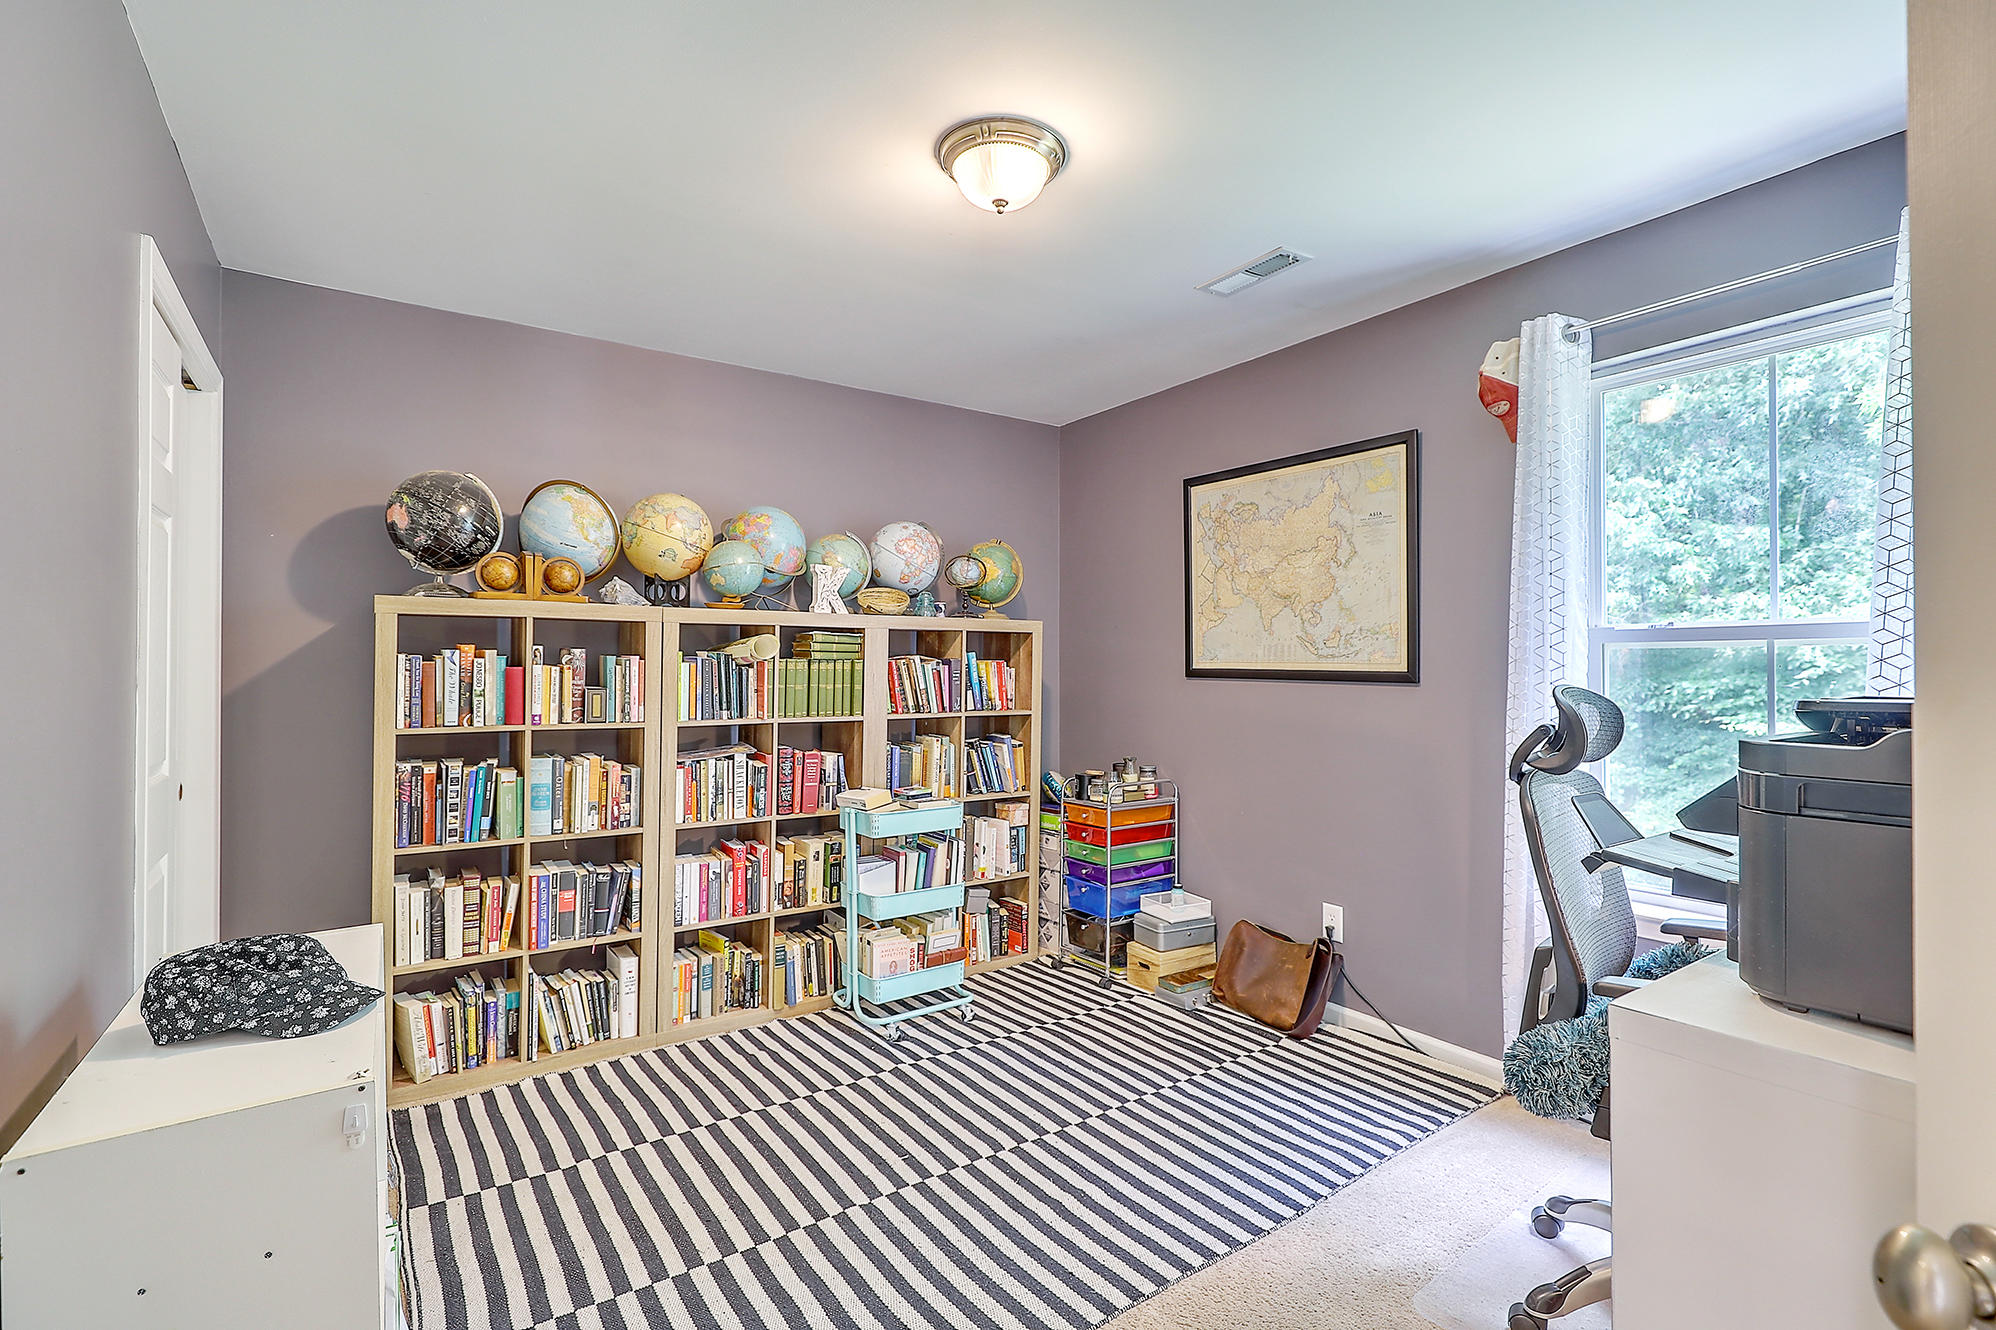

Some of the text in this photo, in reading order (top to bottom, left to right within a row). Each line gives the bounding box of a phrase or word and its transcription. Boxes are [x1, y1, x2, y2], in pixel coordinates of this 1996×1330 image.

[810, 564, 851, 614] K
[399, 782, 411, 803] 1776
[735, 760, 744, 810] SHACKLETON
